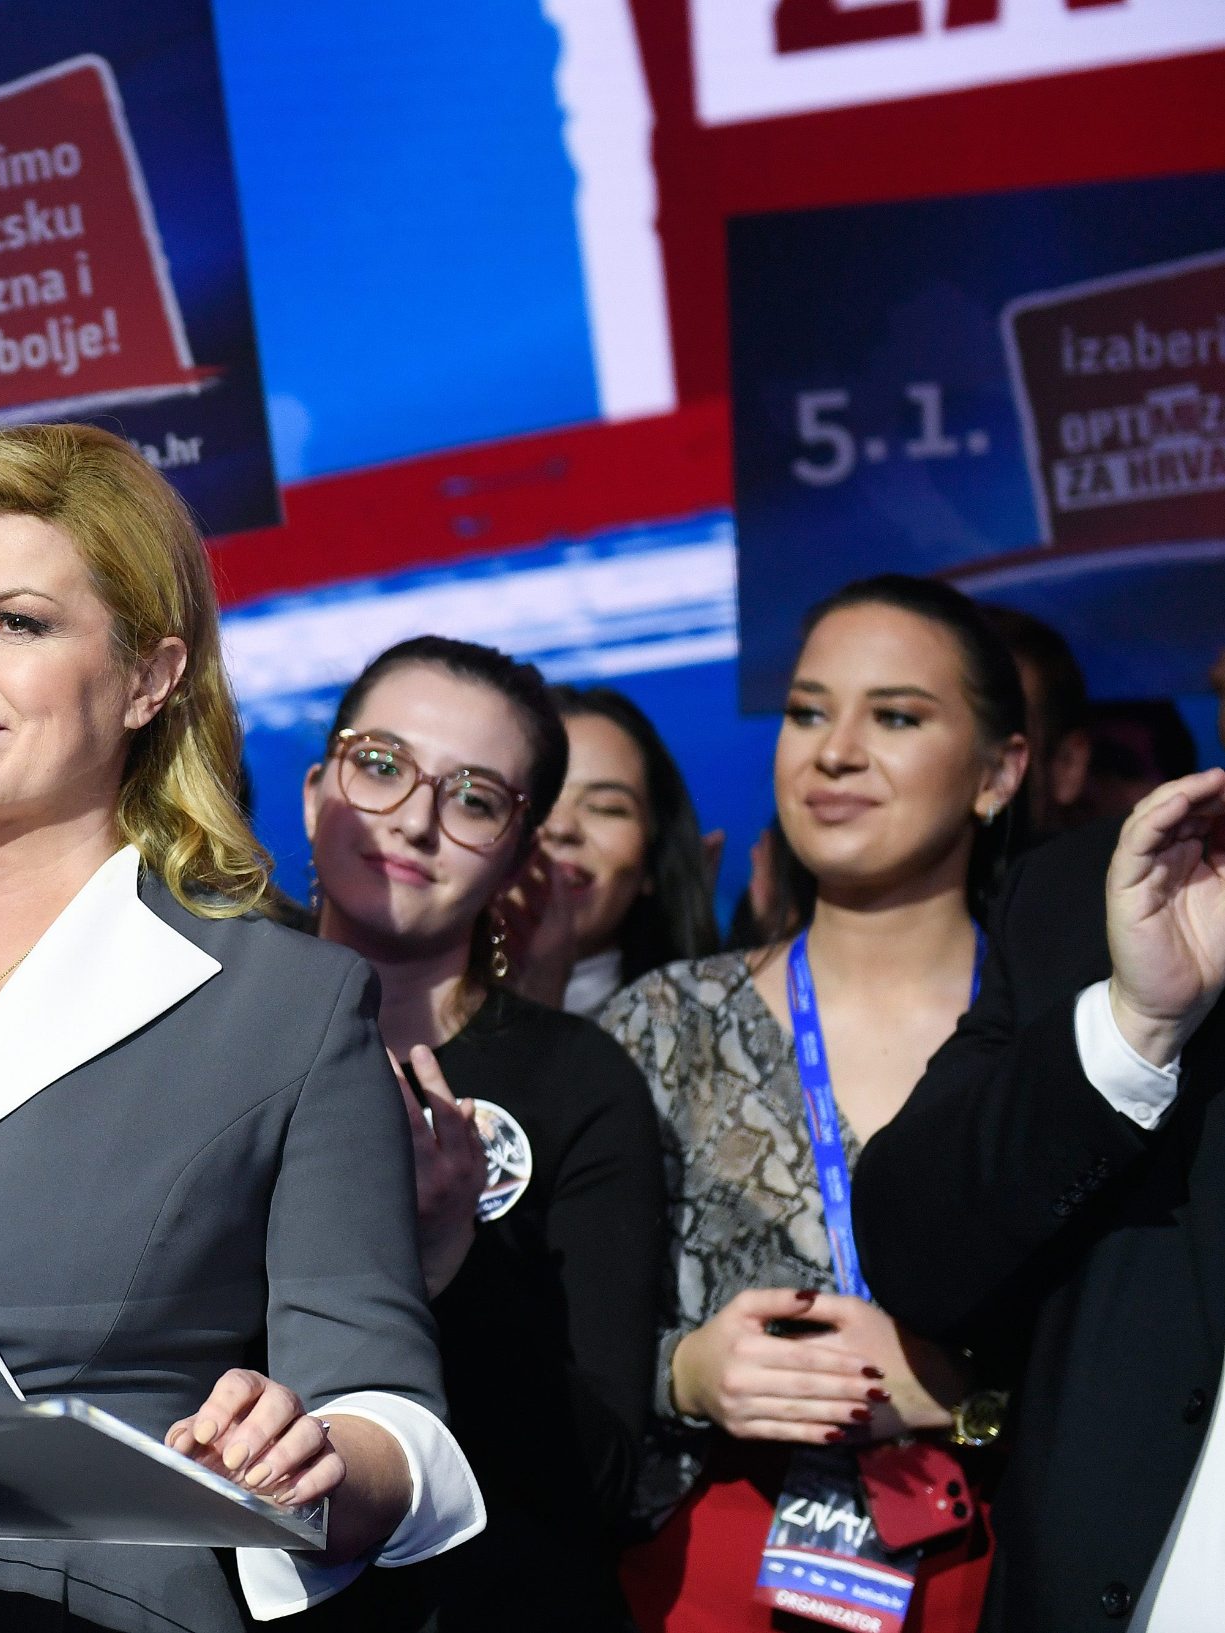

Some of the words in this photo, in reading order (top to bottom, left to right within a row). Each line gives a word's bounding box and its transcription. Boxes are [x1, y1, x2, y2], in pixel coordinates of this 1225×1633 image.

[76, 250, 93, 297] i
[793, 381, 990, 487] 5.1.
[776, 1589, 883, 1633] ORGANIZATOR
